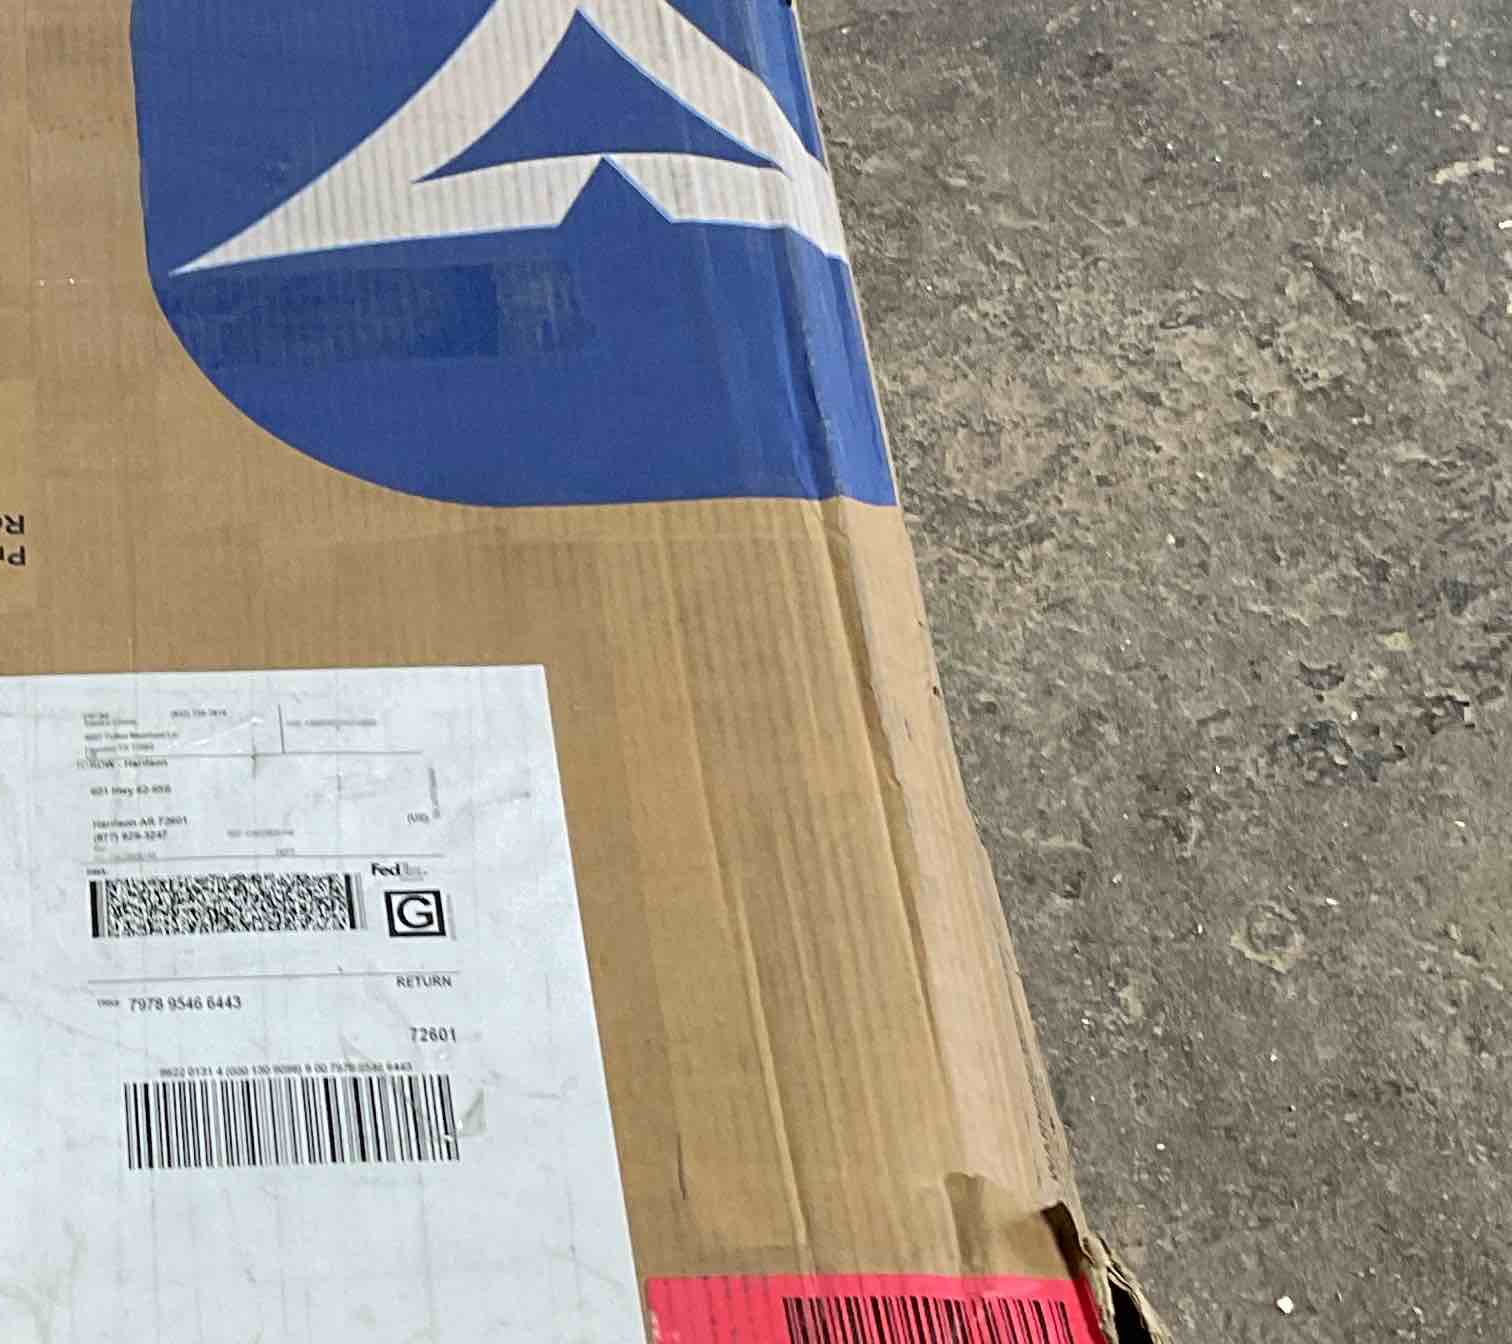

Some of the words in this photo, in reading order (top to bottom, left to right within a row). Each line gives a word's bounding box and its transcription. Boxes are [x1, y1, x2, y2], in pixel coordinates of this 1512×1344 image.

[397, 894, 435, 929] G
[396, 975, 453, 989] RETURN
[128, 997, 164, 1012] 7978
[167, 995, 203, 1011] 9546
[207, 994, 243, 1010] 6443
[409, 1026, 457, 1043] 72601
